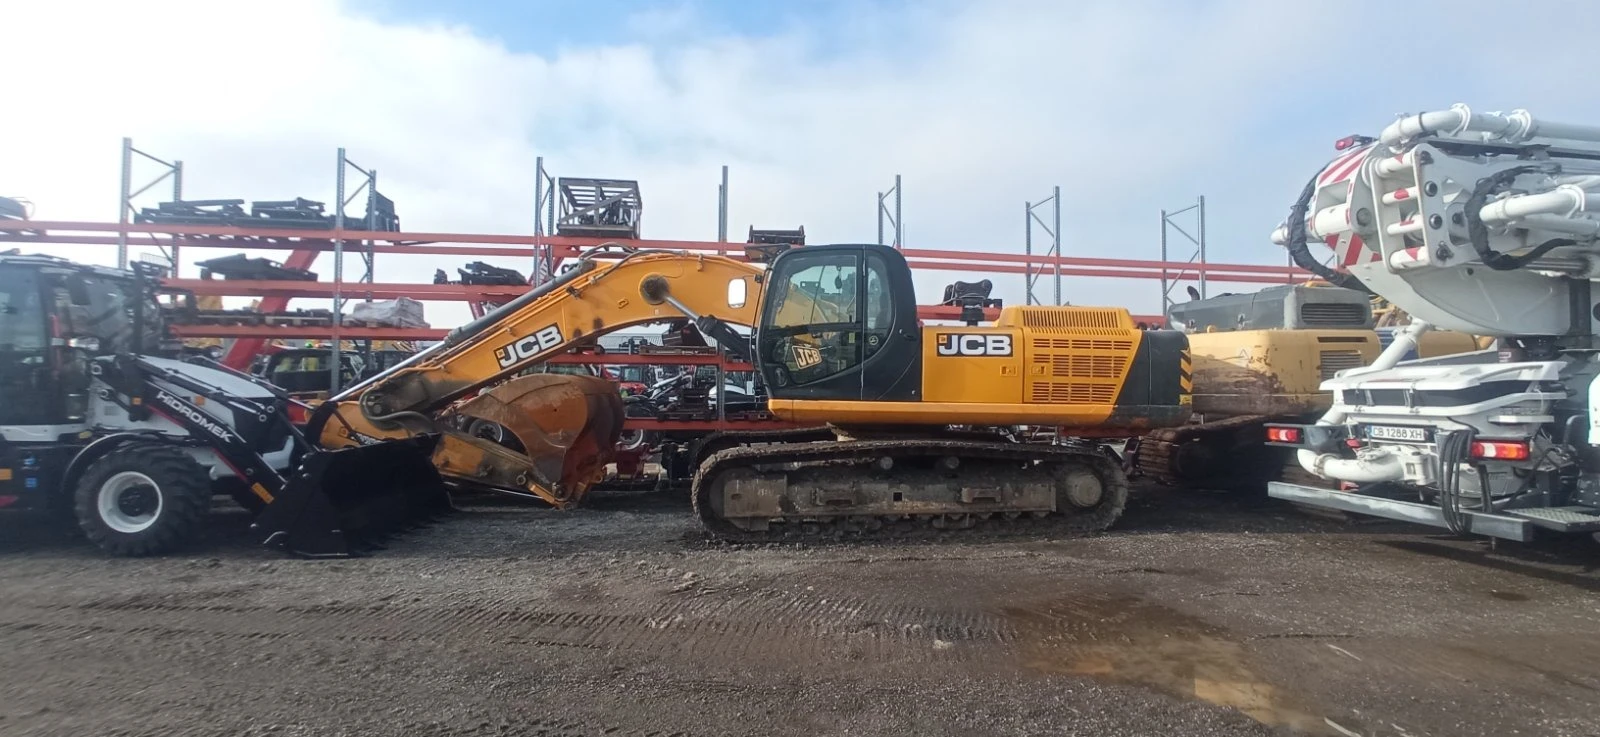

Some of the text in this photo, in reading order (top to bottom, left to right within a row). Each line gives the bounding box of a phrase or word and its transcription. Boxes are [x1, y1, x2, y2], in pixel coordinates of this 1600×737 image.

[499, 326, 562, 368] JCB
[938, 334, 1012, 356] JCB
[797, 348, 820, 367] JCB
[1386, 428, 1408, 439] 1288
[1409, 429, 1423, 439] XH
